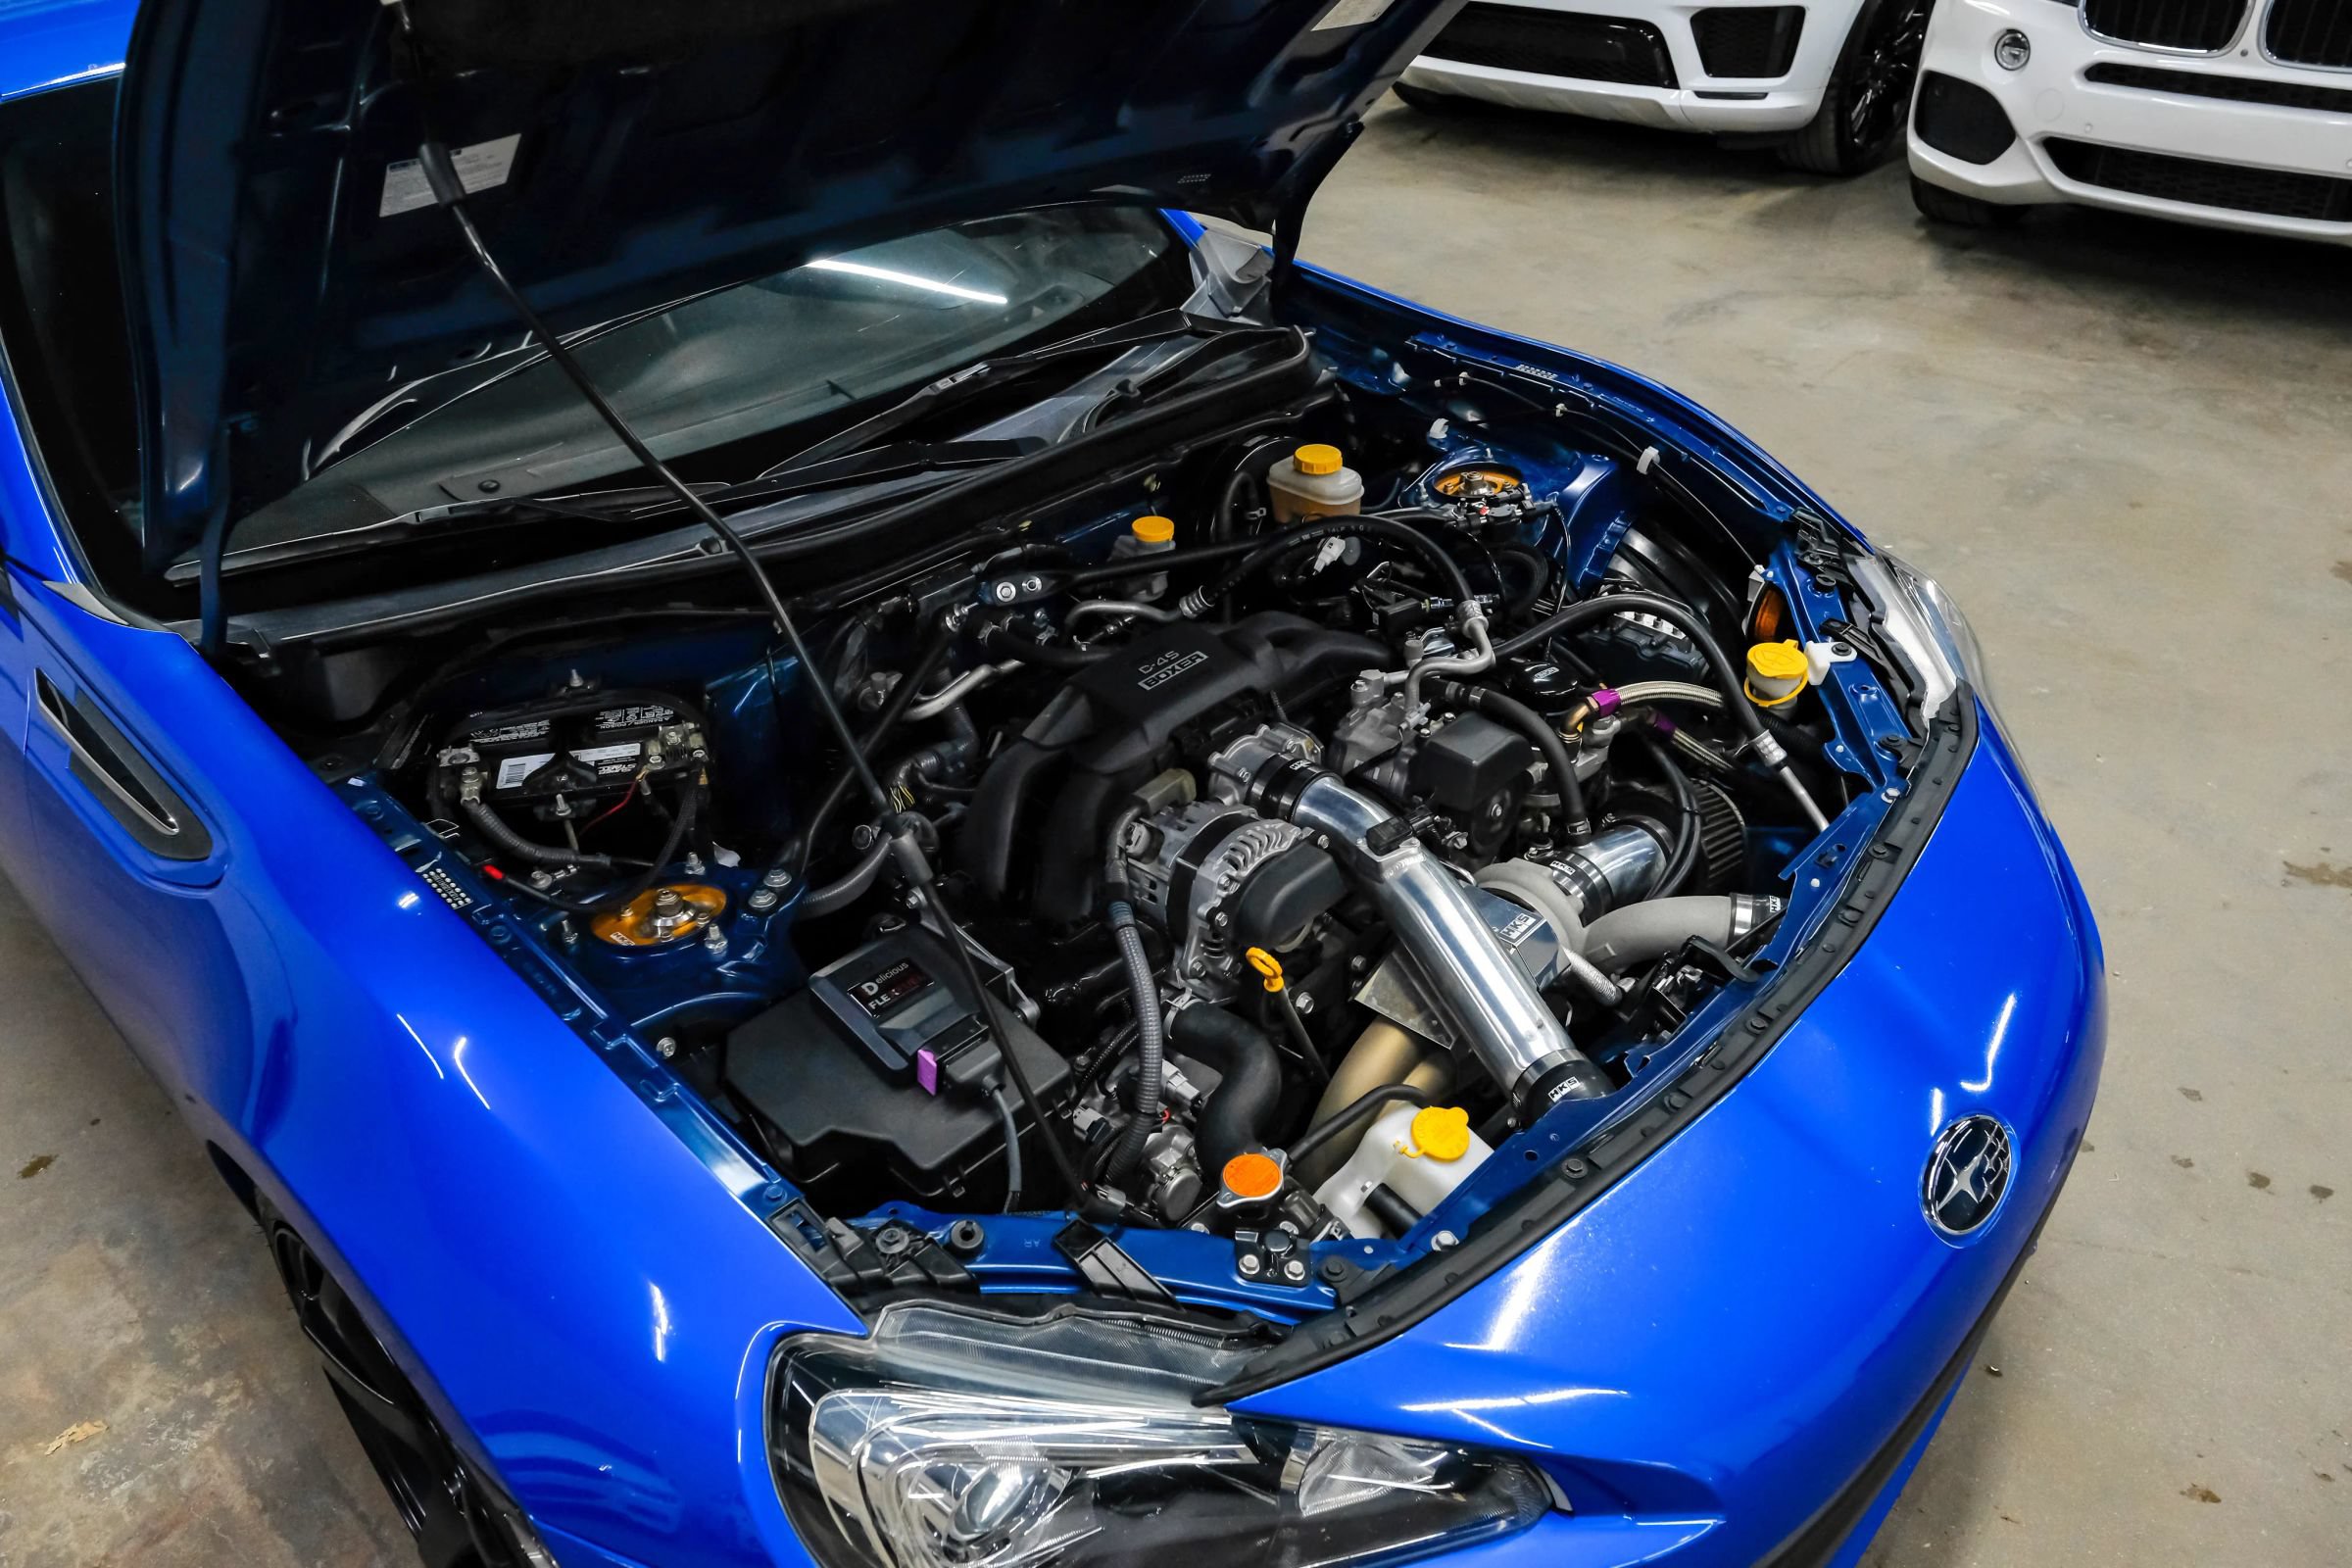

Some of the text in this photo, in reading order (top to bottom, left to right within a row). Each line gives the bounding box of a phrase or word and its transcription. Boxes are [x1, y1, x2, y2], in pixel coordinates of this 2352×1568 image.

[1138, 650, 1180, 674] D-4S
[1140, 652, 1206, 689] BOXER
[1551, 861, 1575, 874] HKS
[1501, 913, 1533, 938] HKS
[860, 962, 909, 996] Delicious
[1548, 1077, 1579, 1101] HKS
